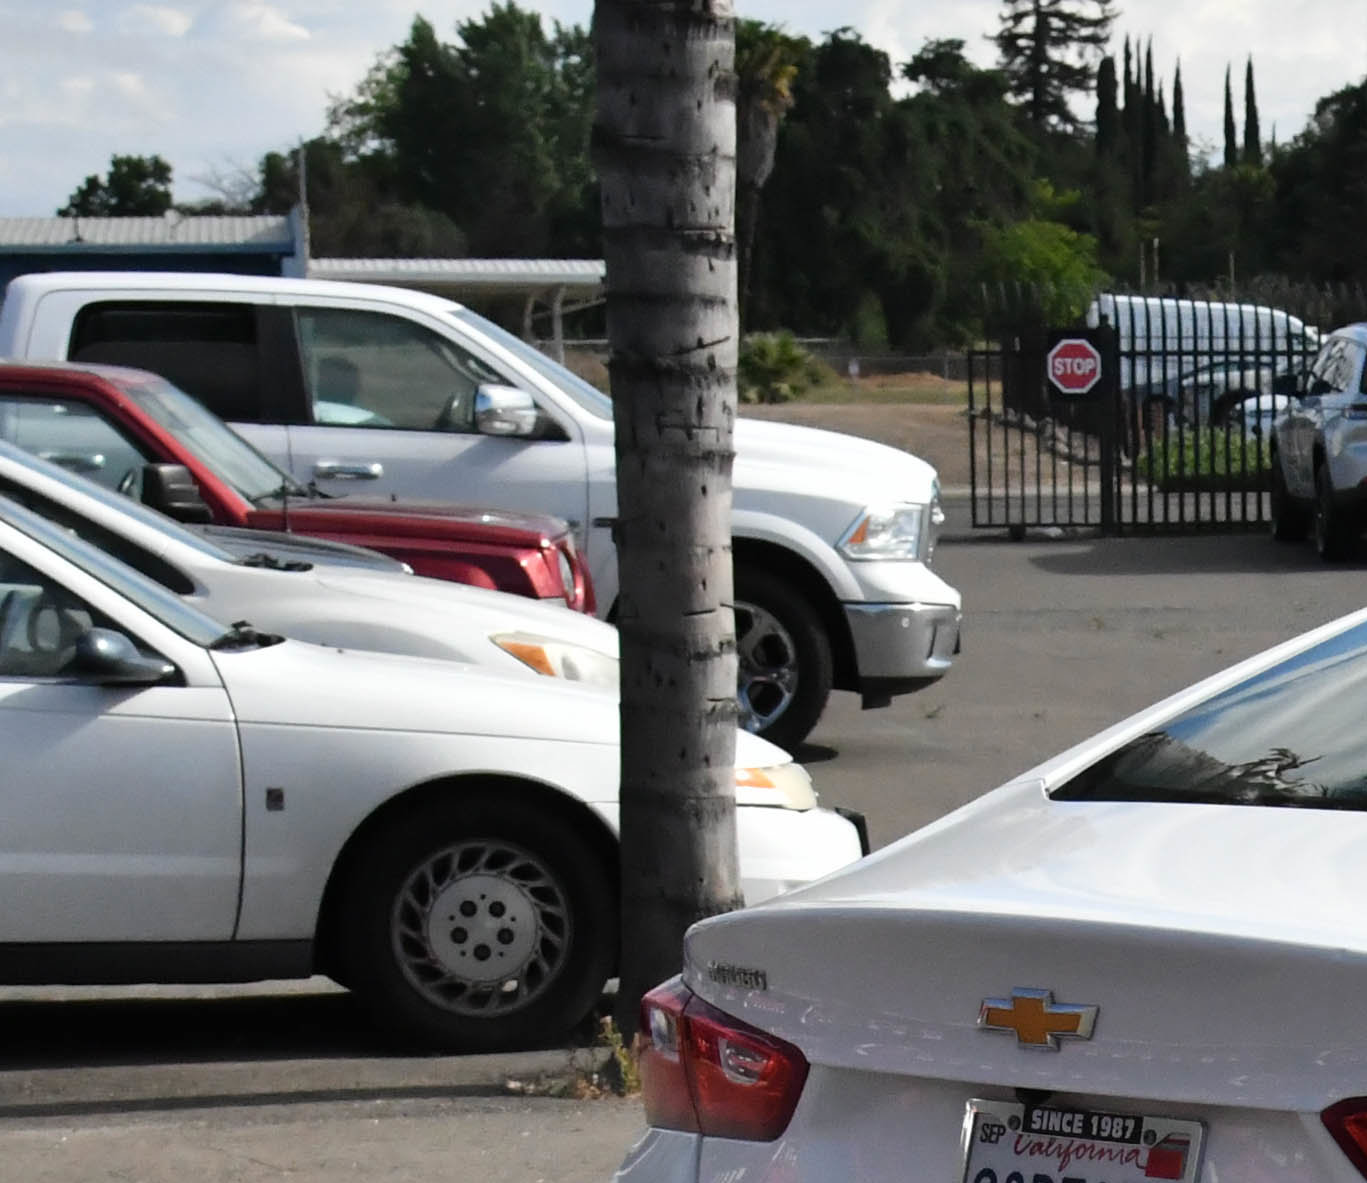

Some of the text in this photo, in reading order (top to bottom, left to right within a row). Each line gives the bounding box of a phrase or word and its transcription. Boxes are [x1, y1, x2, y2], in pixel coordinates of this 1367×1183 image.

[1054, 358, 1095, 375] STOP
[980, 1123, 1006, 1144] SEP
[1031, 1108, 1135, 1140] SINCE 1987
[1013, 1133, 1147, 1172] California
